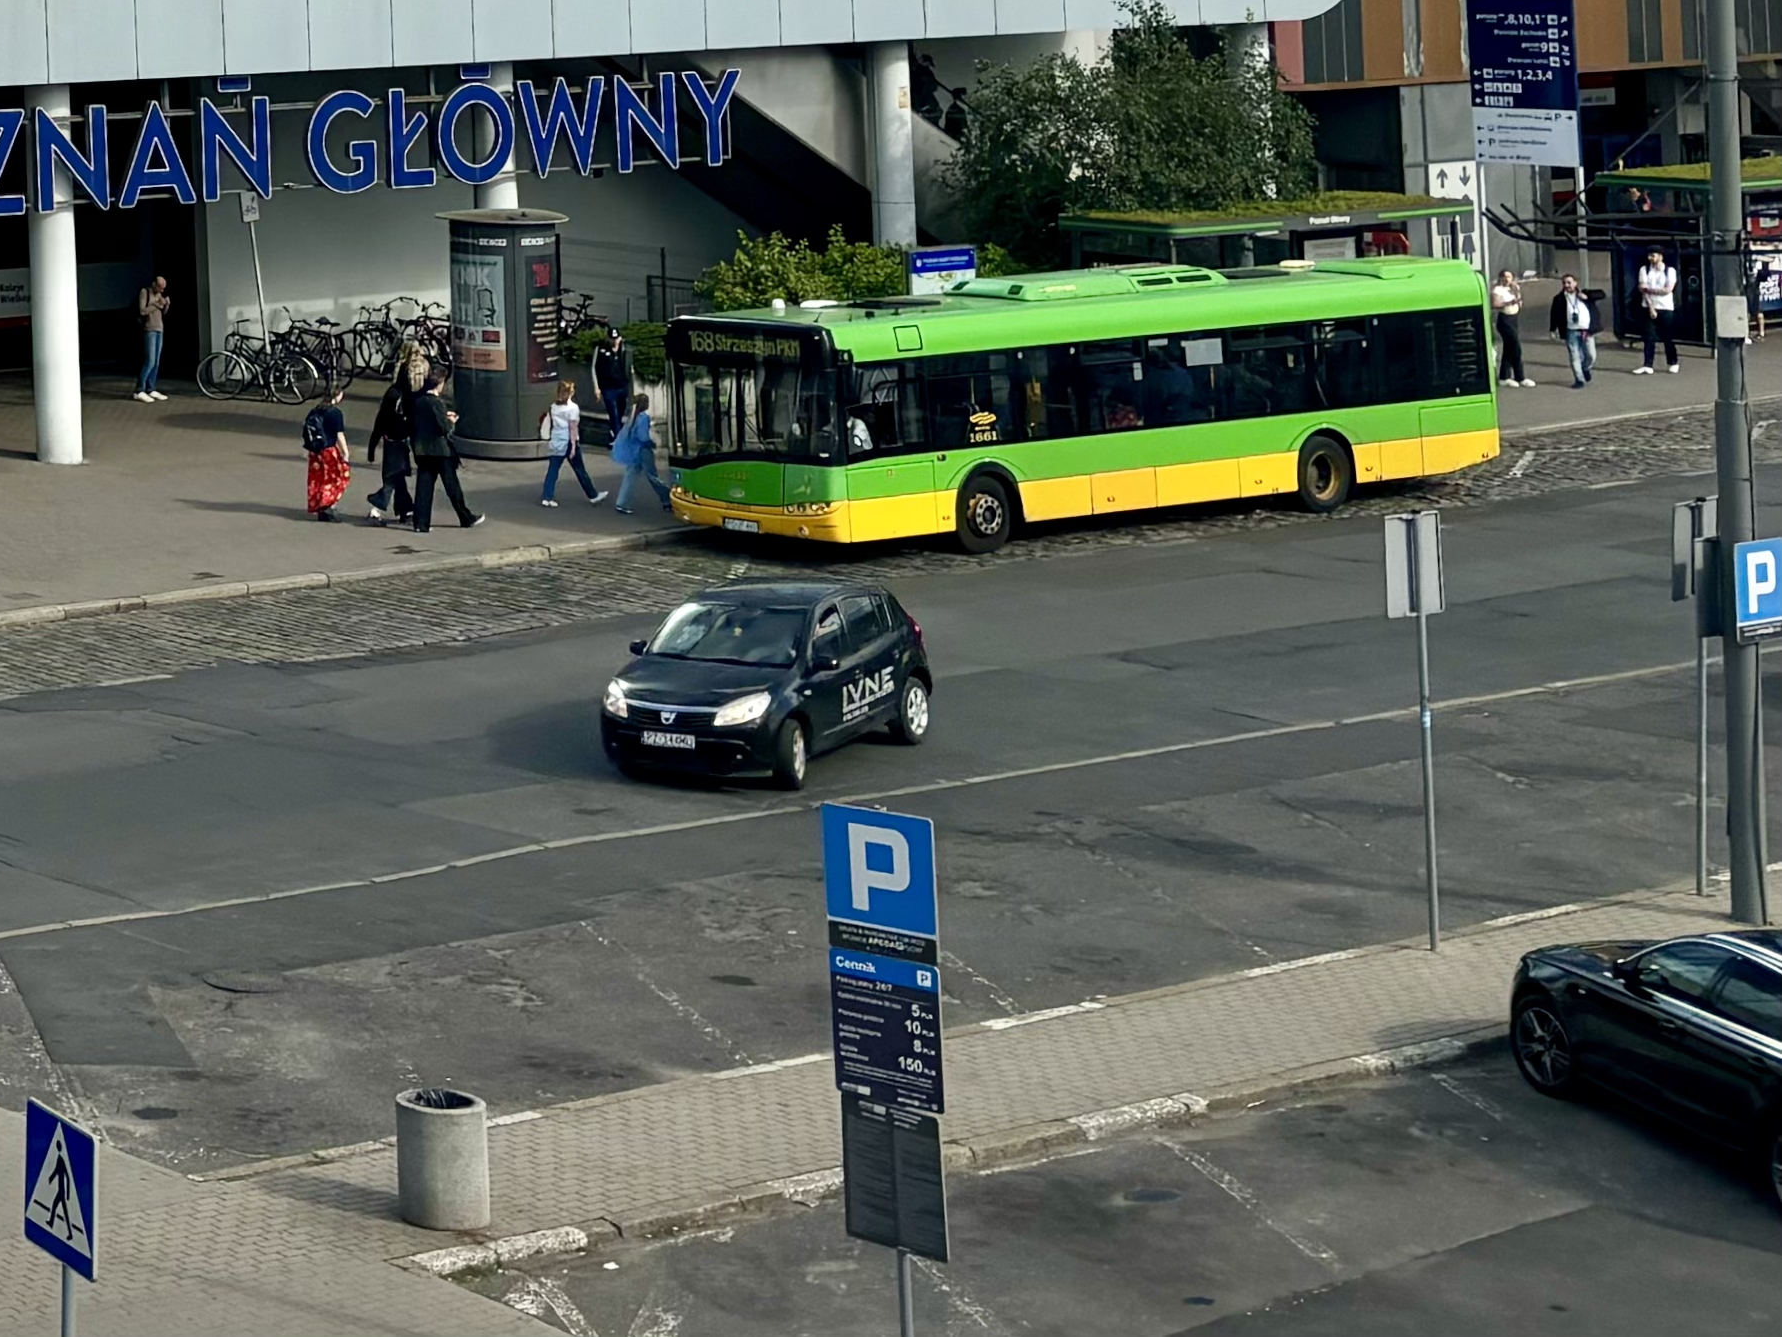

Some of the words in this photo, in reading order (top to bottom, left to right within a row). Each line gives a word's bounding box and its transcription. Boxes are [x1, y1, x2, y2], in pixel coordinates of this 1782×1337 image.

[1517, 69, 1553, 81] 1,2,3,4
[307, 63, 742, 194] GŁÓWNY
[688, 330, 714, 353] 168
[715, 334, 776, 357] Strzeszyn
[969, 430, 998, 443] 1661
[1746, 550, 1777, 615] P
[848, 822, 911, 912] P
[835, 956, 877, 974] Cennik
[911, 1004, 921, 1017] 5
[904, 1020, 922, 1035] 10
[898, 1056, 923, 1074] 150
